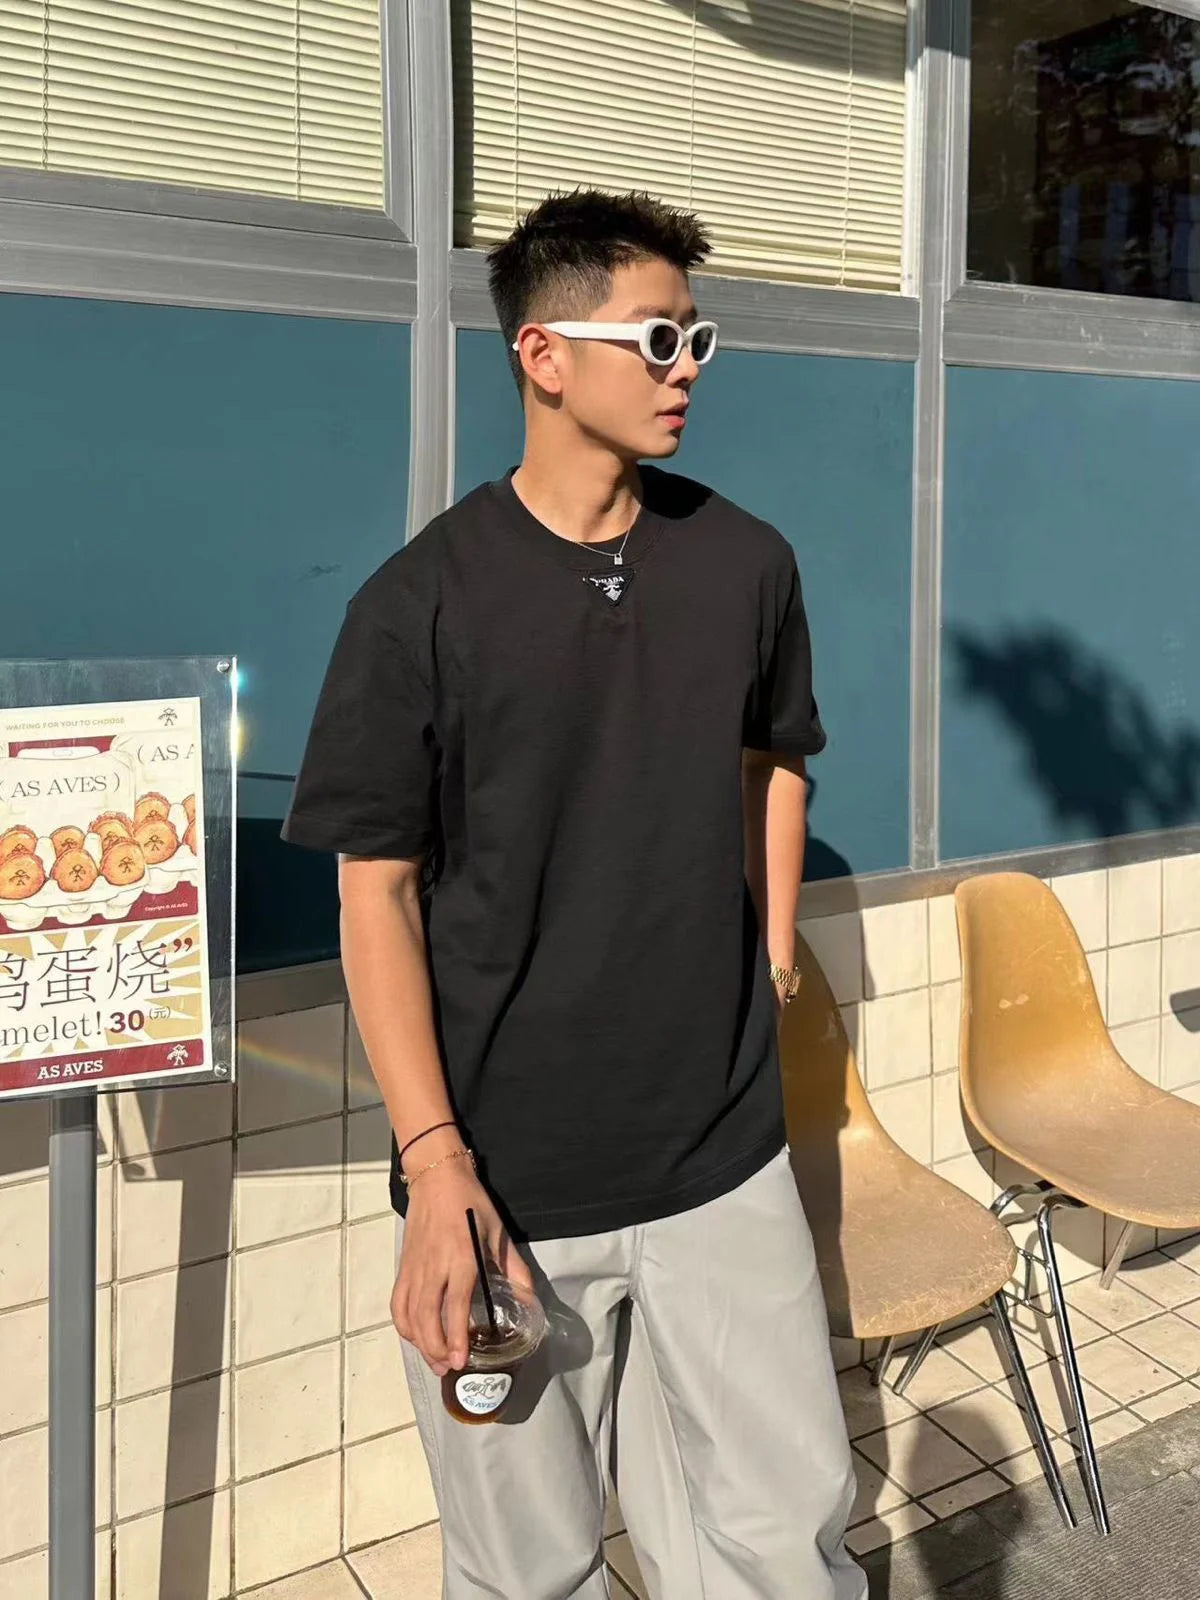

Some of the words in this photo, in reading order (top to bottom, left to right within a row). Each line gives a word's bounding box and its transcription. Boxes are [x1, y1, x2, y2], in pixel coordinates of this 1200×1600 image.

[6, 722, 41, 731] WAITING
[43, 721, 59, 729] FOR
[61, 720, 78, 728] YOU
[80, 719, 91, 727] TO
[92, 717, 125, 726] CHOOSE
[0, 1011, 102, 1047] melet!
[110, 1009, 145, 1033] 30
[37, 1066, 60, 1080] AS
[63, 1060, 103, 1077] AVES
